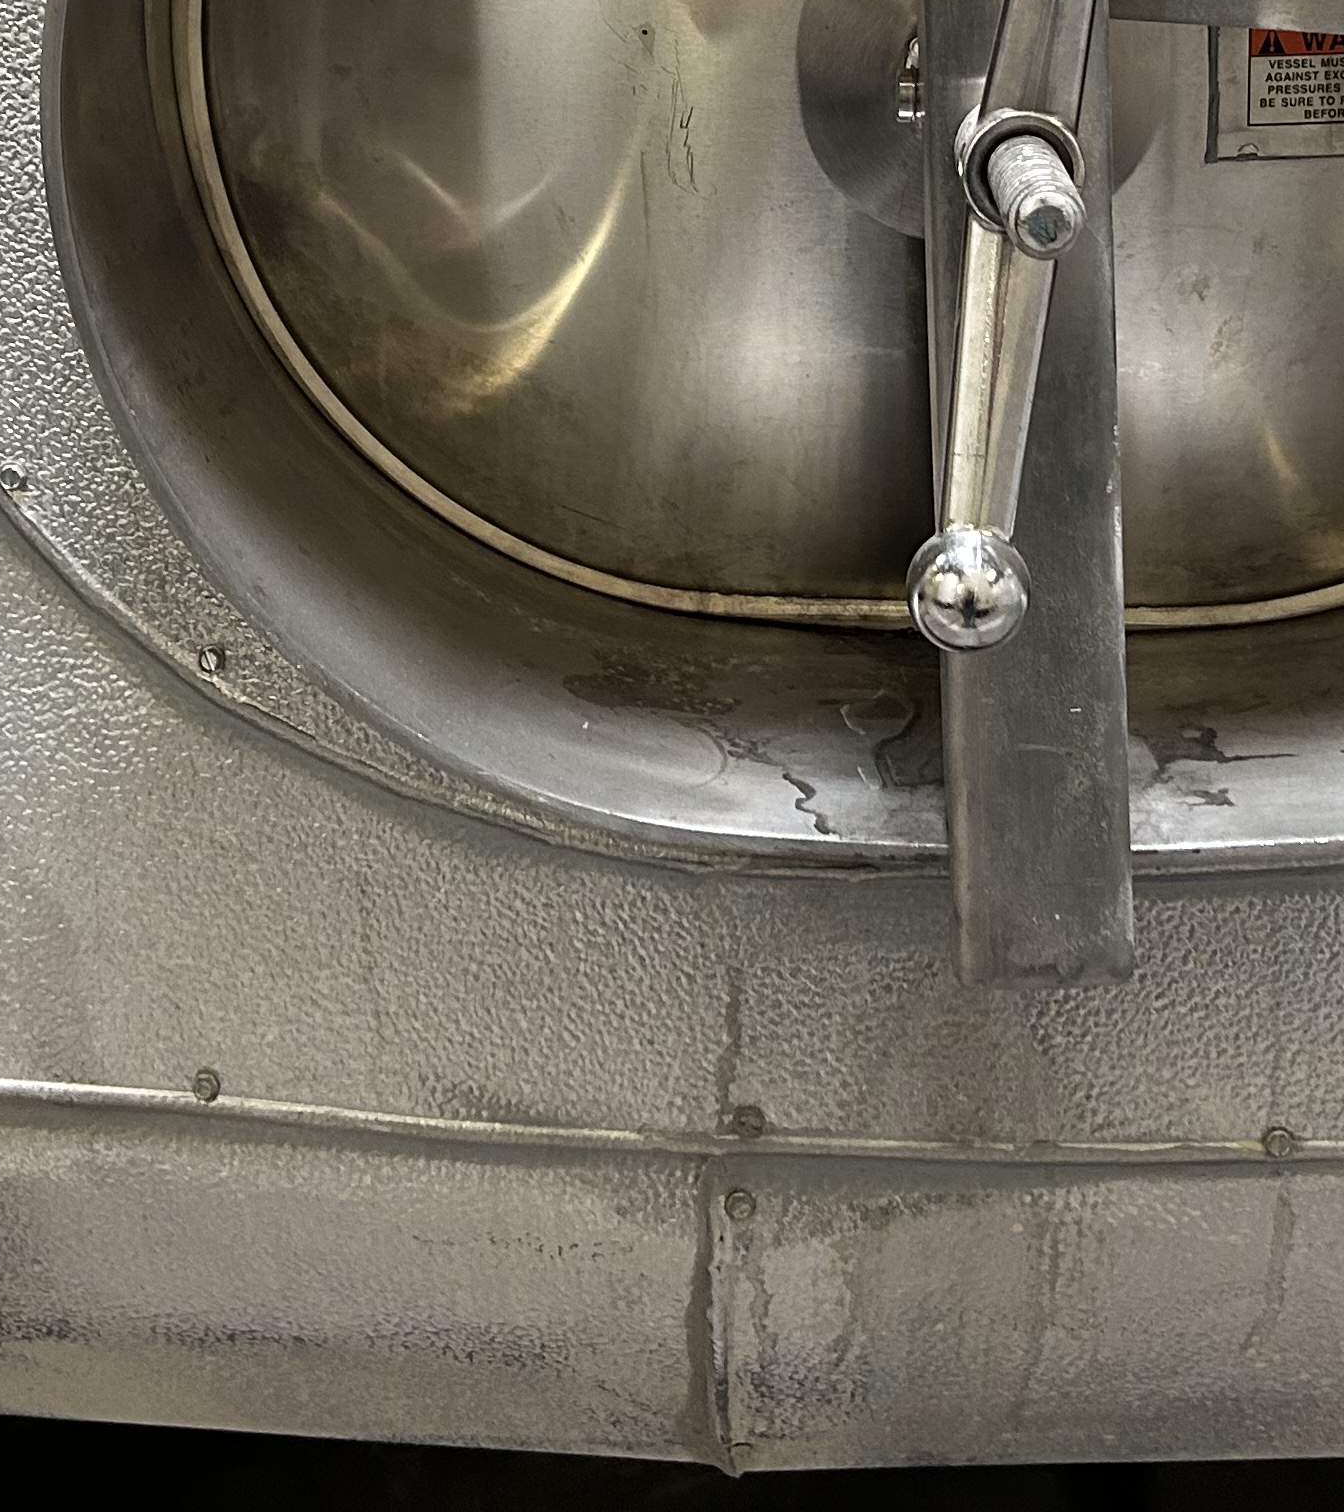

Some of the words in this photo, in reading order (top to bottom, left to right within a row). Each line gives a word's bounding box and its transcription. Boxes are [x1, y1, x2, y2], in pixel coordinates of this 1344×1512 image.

[1268, 58, 1317, 70] VESSEL
[1265, 70, 1319, 83] AGAINST
[1267, 83, 1341, 95] PRESSURES
[1259, 98, 1276, 108] BE
[1280, 97, 1314, 108] SURE
[1319, 95, 1335, 106] TO
